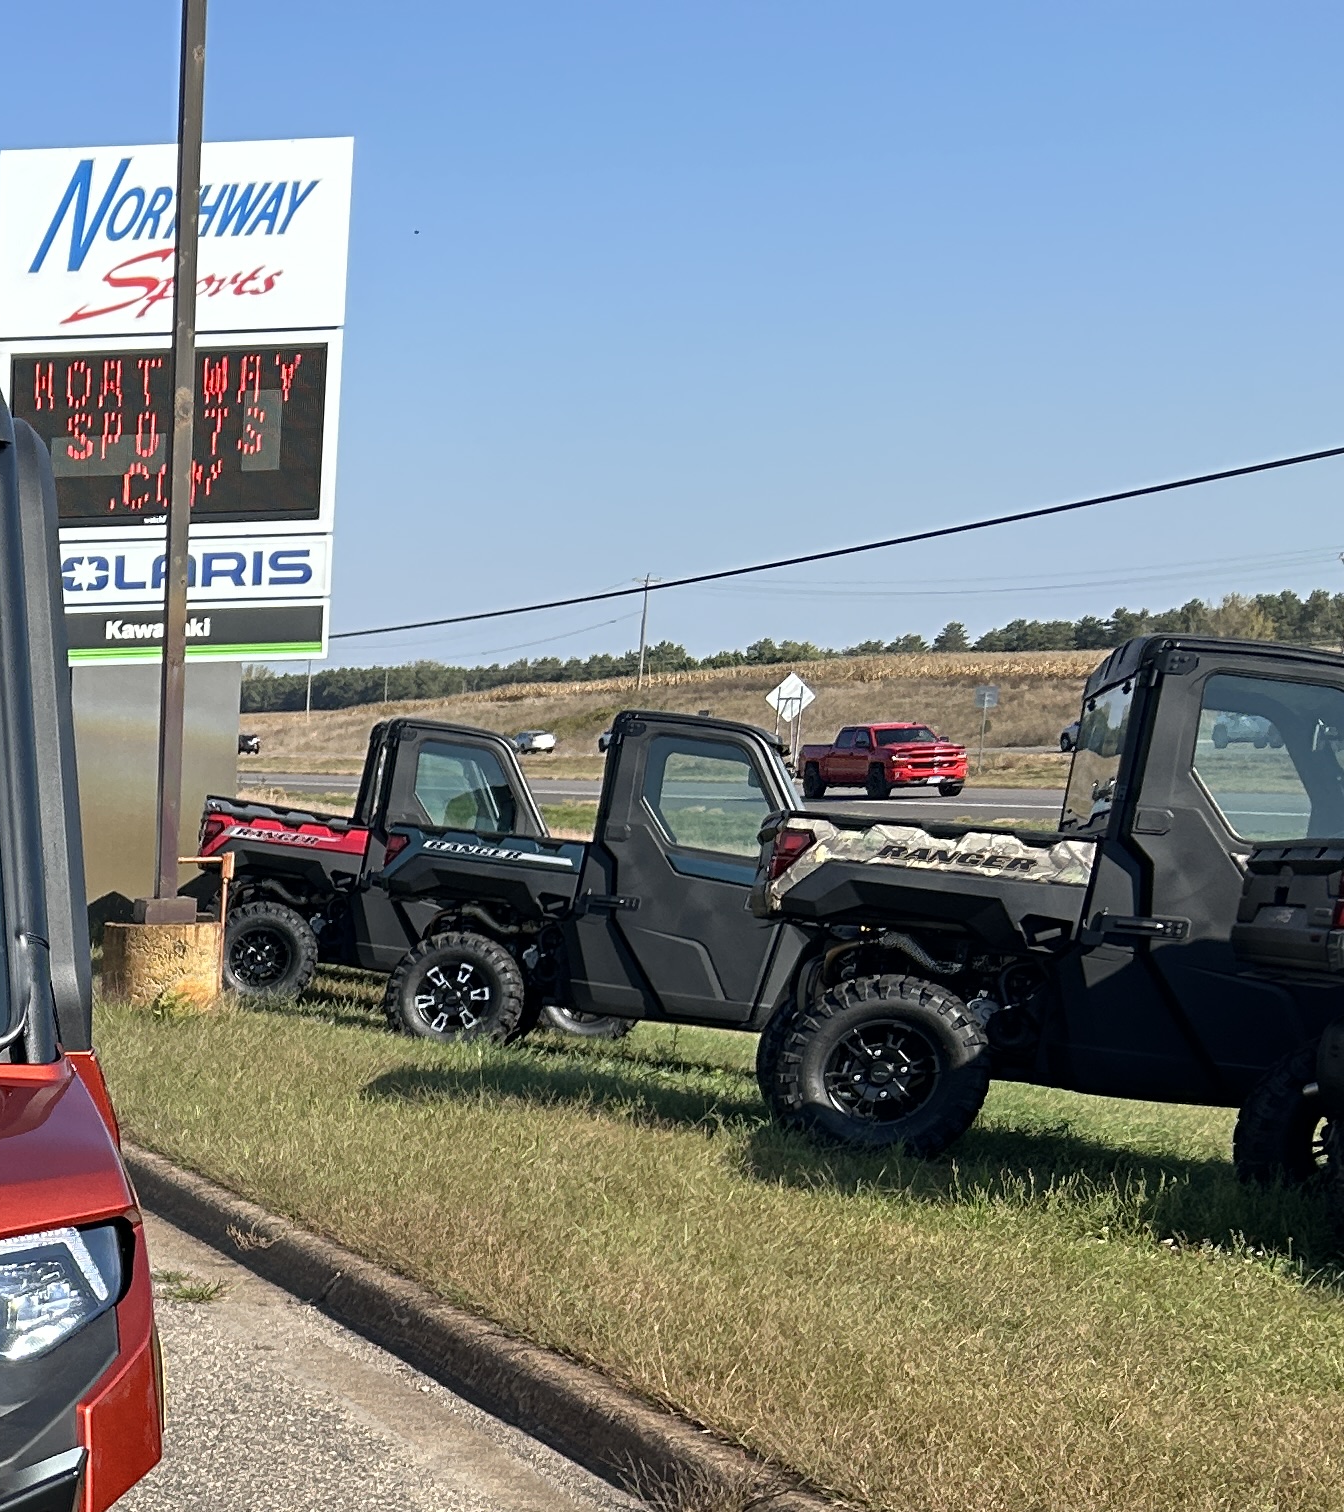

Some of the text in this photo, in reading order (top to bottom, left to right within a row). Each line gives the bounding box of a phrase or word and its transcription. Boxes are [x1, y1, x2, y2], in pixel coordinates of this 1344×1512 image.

[28, 156, 321, 274] NORHWAY
[66, 406, 265, 461] SPOTS
[62, 549, 313, 592] OLARIS
[105, 617, 211, 640] Kawaki
[235, 827, 320, 846] RANGER
[426, 840, 523, 861] RANGER
[875, 845, 1038, 873] RANGER
